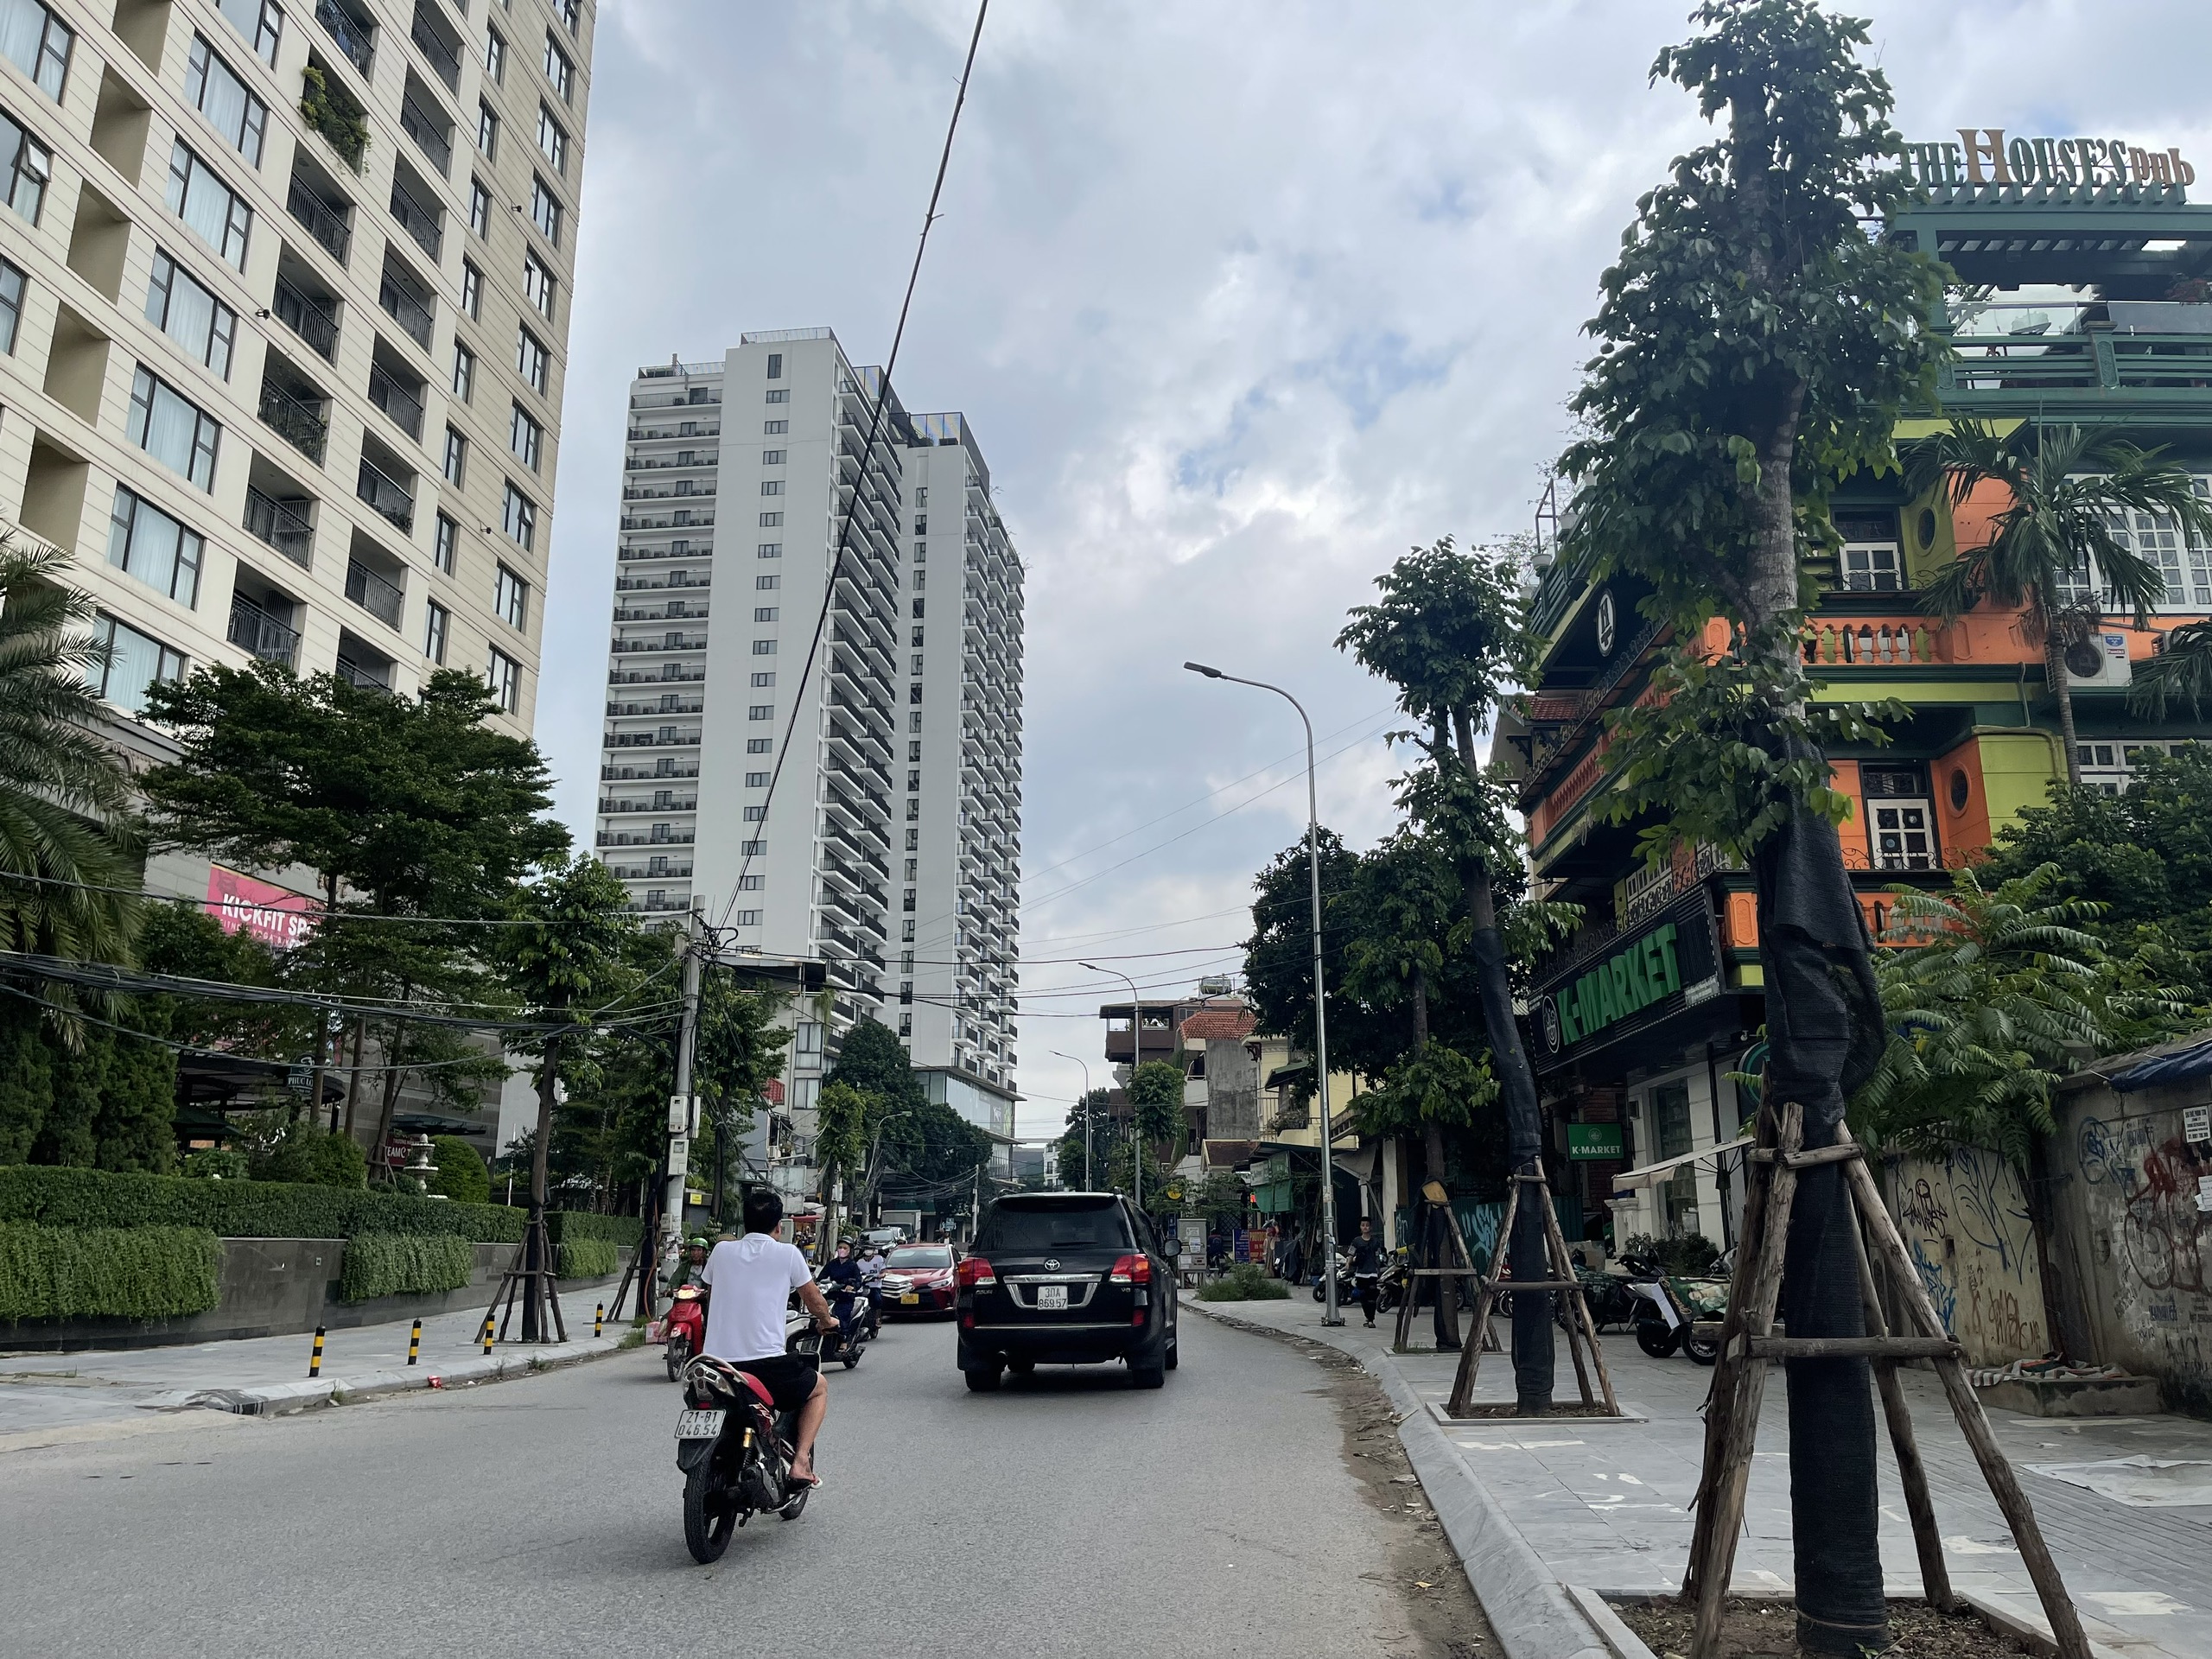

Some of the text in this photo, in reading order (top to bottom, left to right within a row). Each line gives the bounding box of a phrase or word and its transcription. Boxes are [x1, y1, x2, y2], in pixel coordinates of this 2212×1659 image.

[1956, 128, 2126, 187] HOUSE'S
[222, 893, 286, 932] KICKFIT
[1556, 923, 1681, 1046] K-MARKET
[1045, 1287, 1061, 1298] 30A
[677, 1424, 717, 1436] 046.54
[686, 1411, 718, 1424] 21-B1
